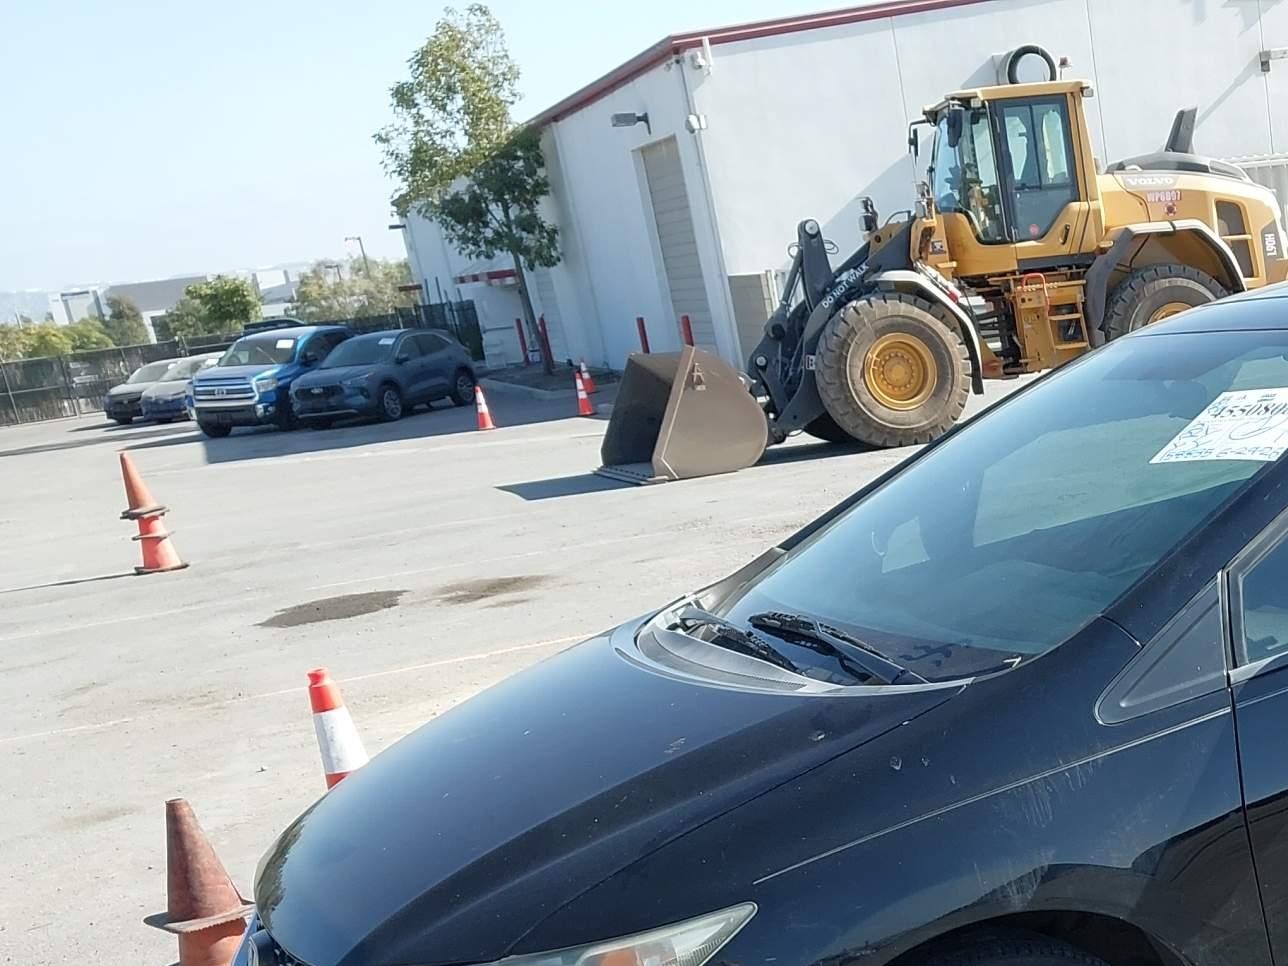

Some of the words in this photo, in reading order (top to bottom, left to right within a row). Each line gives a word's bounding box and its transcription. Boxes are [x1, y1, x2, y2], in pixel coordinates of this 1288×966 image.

[1127, 177, 1174, 186] VOLVO
[1263, 233, 1277, 256] L90H
[822, 295, 835, 309] DO
[831, 279, 850, 298] NOT
